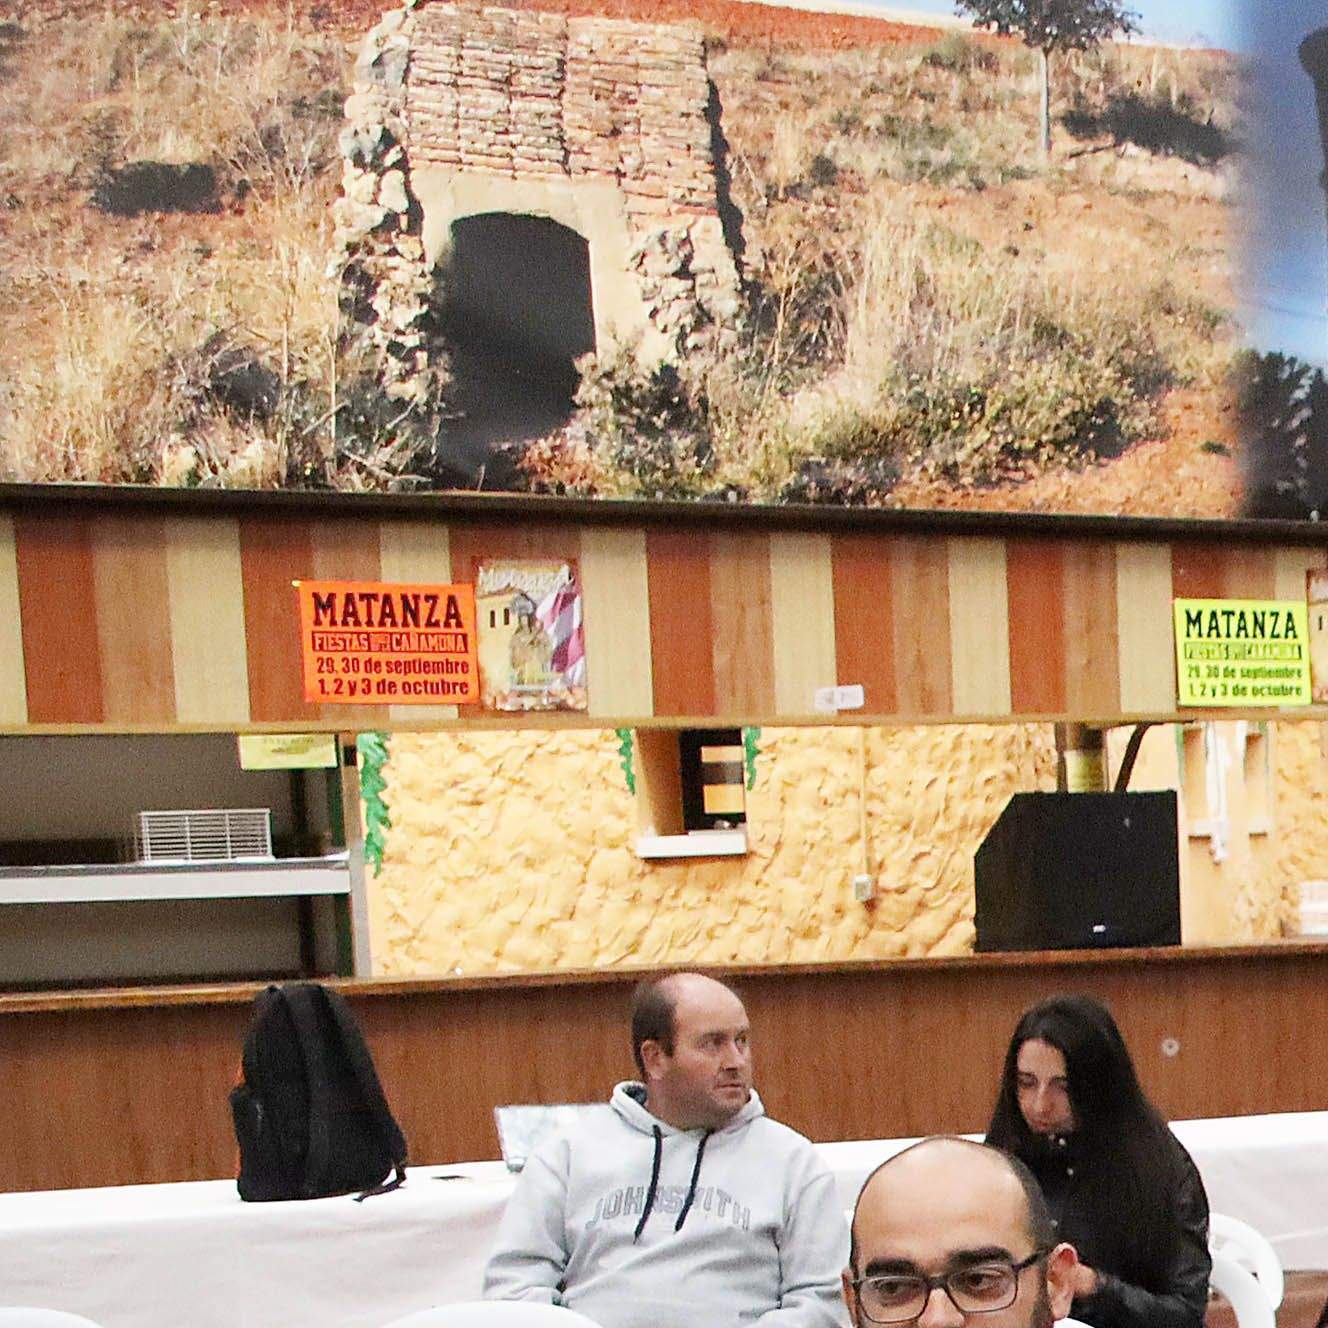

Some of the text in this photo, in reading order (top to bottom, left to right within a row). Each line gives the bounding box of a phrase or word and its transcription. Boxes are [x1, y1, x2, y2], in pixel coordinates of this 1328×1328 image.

[312, 592, 464, 628] MATANZA
[1185, 609, 1298, 639] MATANZA
[314, 633, 369, 651] FIESTAS
[341, 657, 360, 674] 30
[364, 657, 382, 674] de
[385, 657, 469, 677] septiembre
[333, 678, 344, 695] 2
[347, 679, 357, 697] y
[361, 678, 371, 695] 3
[376, 678, 397, 696] de
[401, 678, 469, 696] octubre
